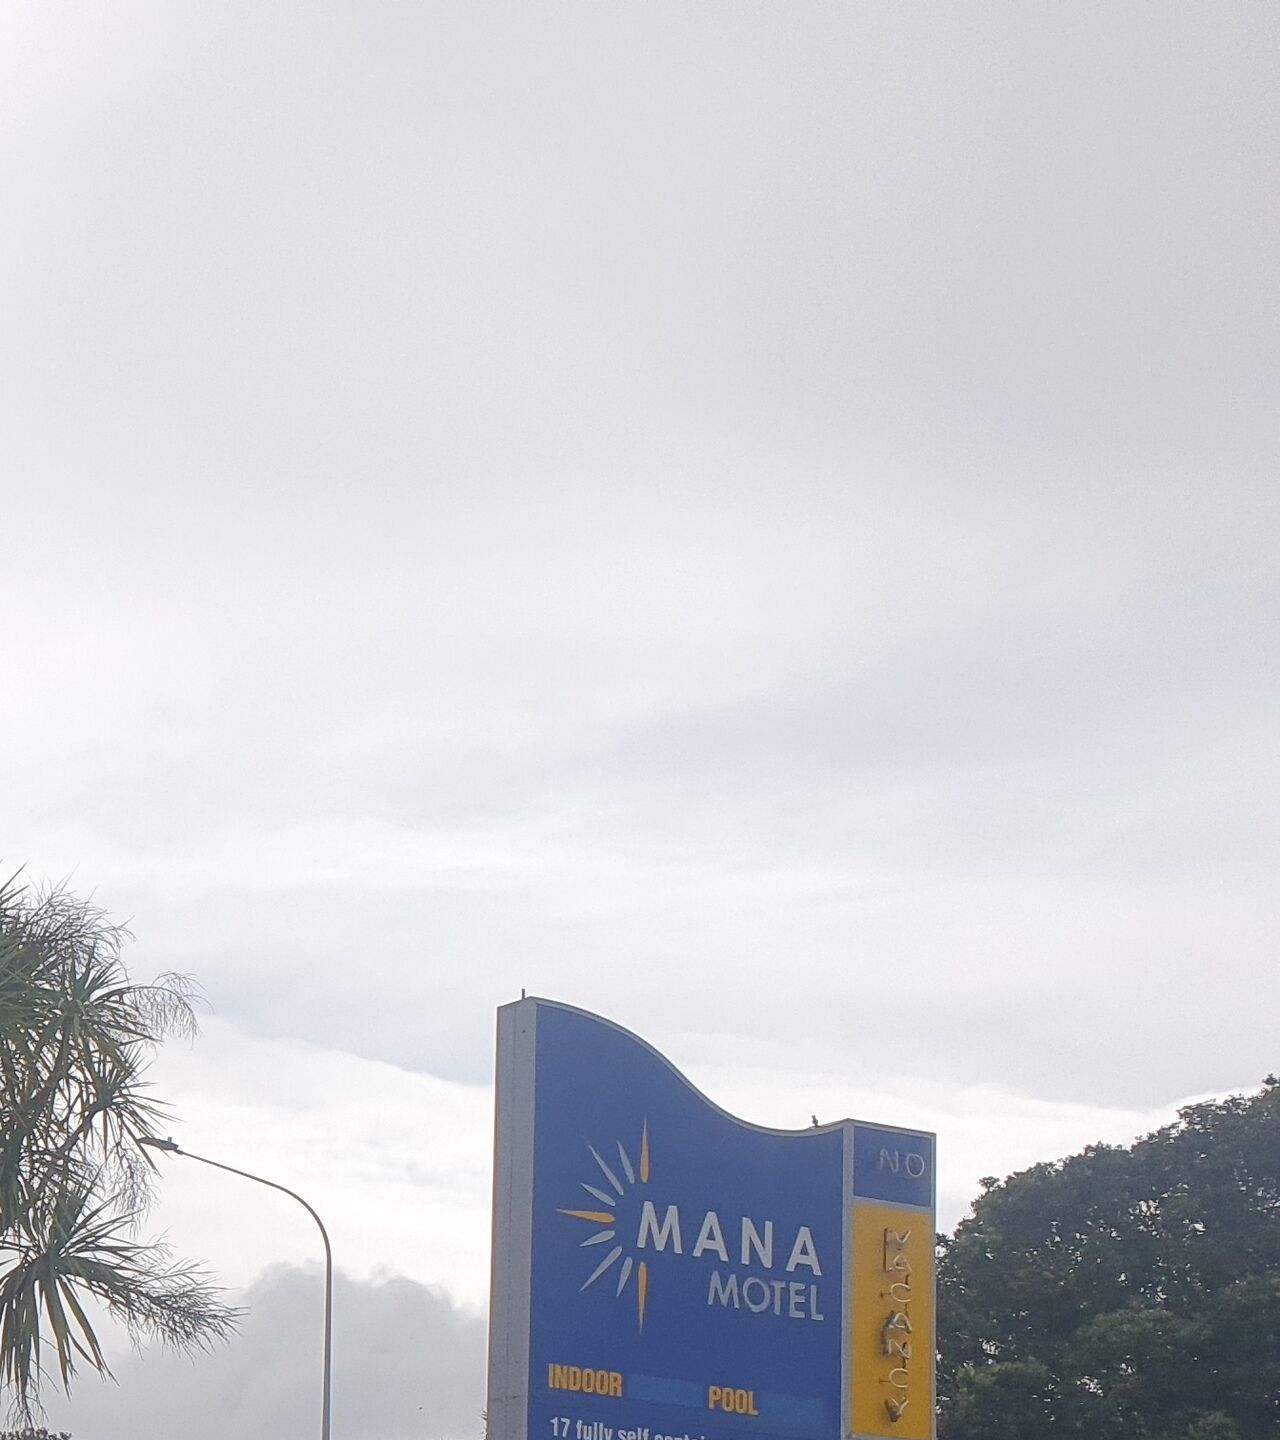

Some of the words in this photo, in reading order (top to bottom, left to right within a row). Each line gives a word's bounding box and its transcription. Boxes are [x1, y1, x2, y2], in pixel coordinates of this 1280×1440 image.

[879, 1147, 925, 1179] NO
[637, 1201, 822, 1276] MANA
[707, 1270, 824, 1321] MOTEL
[548, 1364, 623, 1398] INDOOR
[708, 1385, 759, 1417] POOL
[549, 1417, 569, 1438] 17
